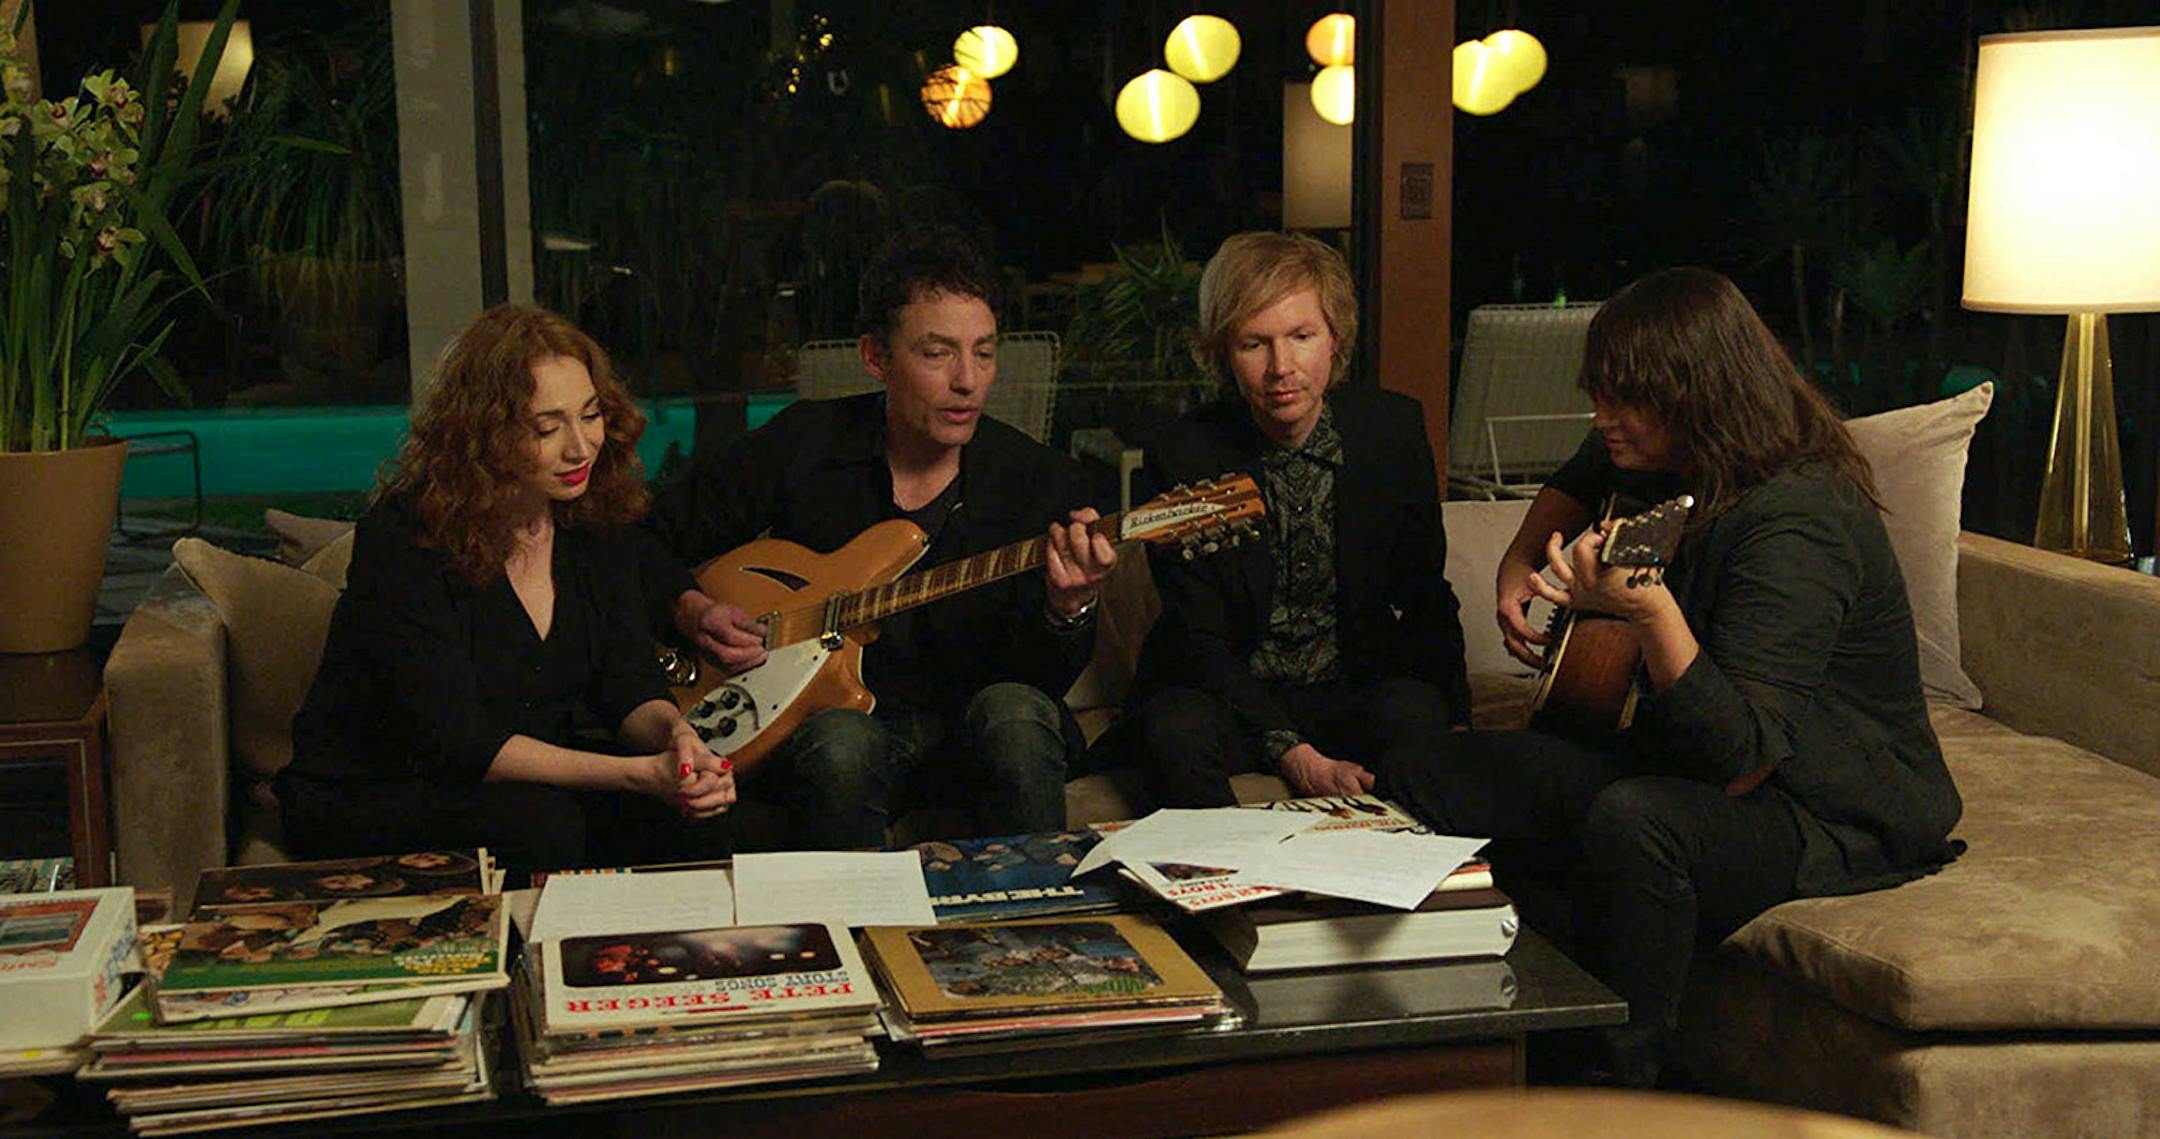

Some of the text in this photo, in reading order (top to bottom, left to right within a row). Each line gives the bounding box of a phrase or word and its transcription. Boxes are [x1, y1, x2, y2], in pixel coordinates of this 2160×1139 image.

[1008, 885, 1085, 901] THE
[715, 970, 850, 992] STORY SONGS
[566, 982, 855, 1012] PETE SEEGER
